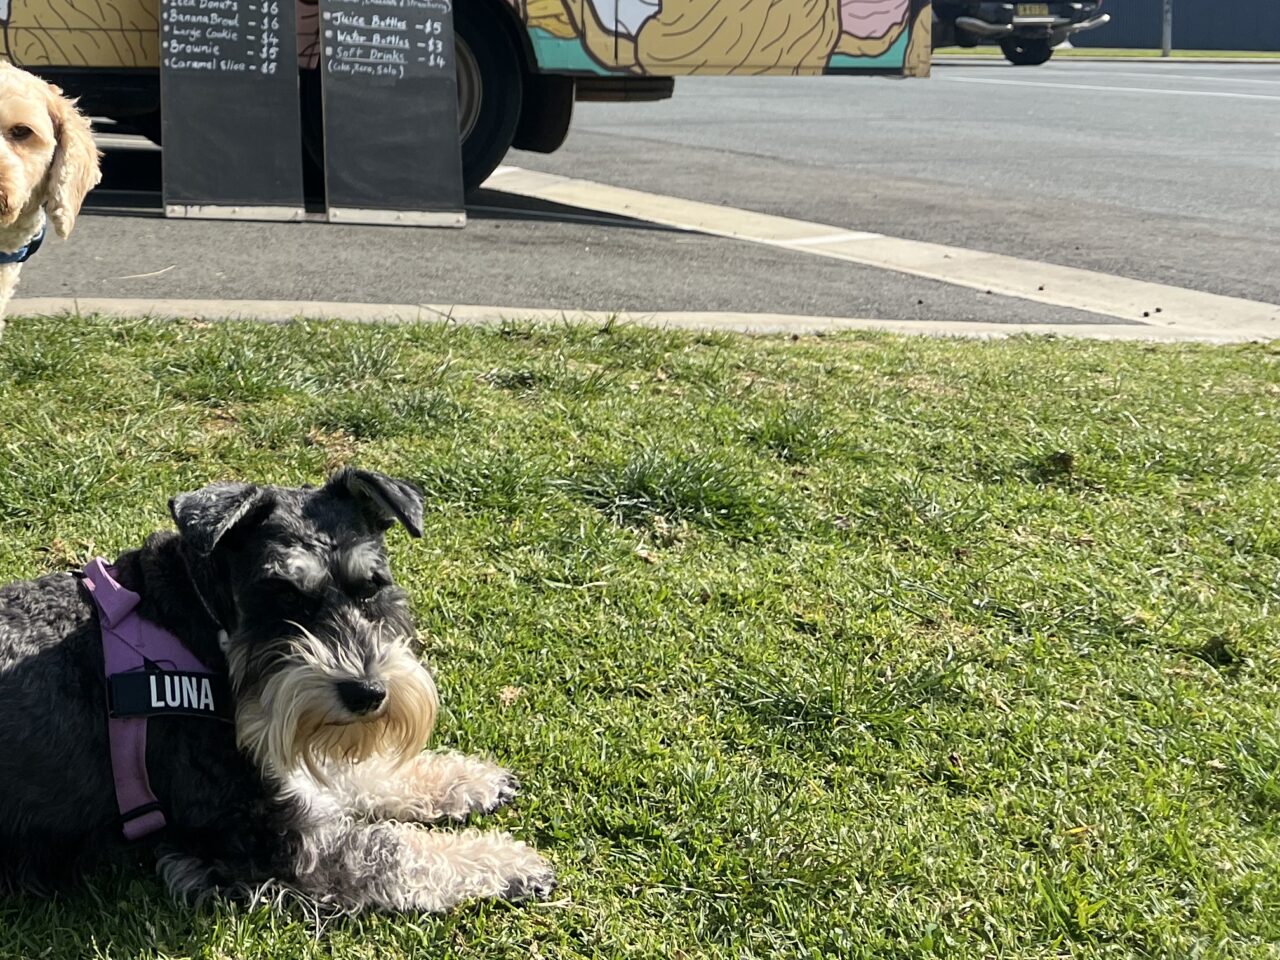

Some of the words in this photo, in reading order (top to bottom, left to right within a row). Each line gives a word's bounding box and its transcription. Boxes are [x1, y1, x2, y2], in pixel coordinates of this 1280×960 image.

[169, 8, 210, 25] Banana
[331, 11, 366, 27] Juice
[371, 14, 408, 30] Bottles
[172, 25, 201, 41] Large
[205, 26, 238, 41] Cookie
[336, 29, 367, 43] Water
[372, 32, 410, 49] Bottles
[169, 39, 220, 56] Brownie
[335, 46, 363, 59] Soft
[369, 48, 405, 61] Drinks
[170, 56, 217, 71] Caramel
[149, 674, 215, 712] LUNA
